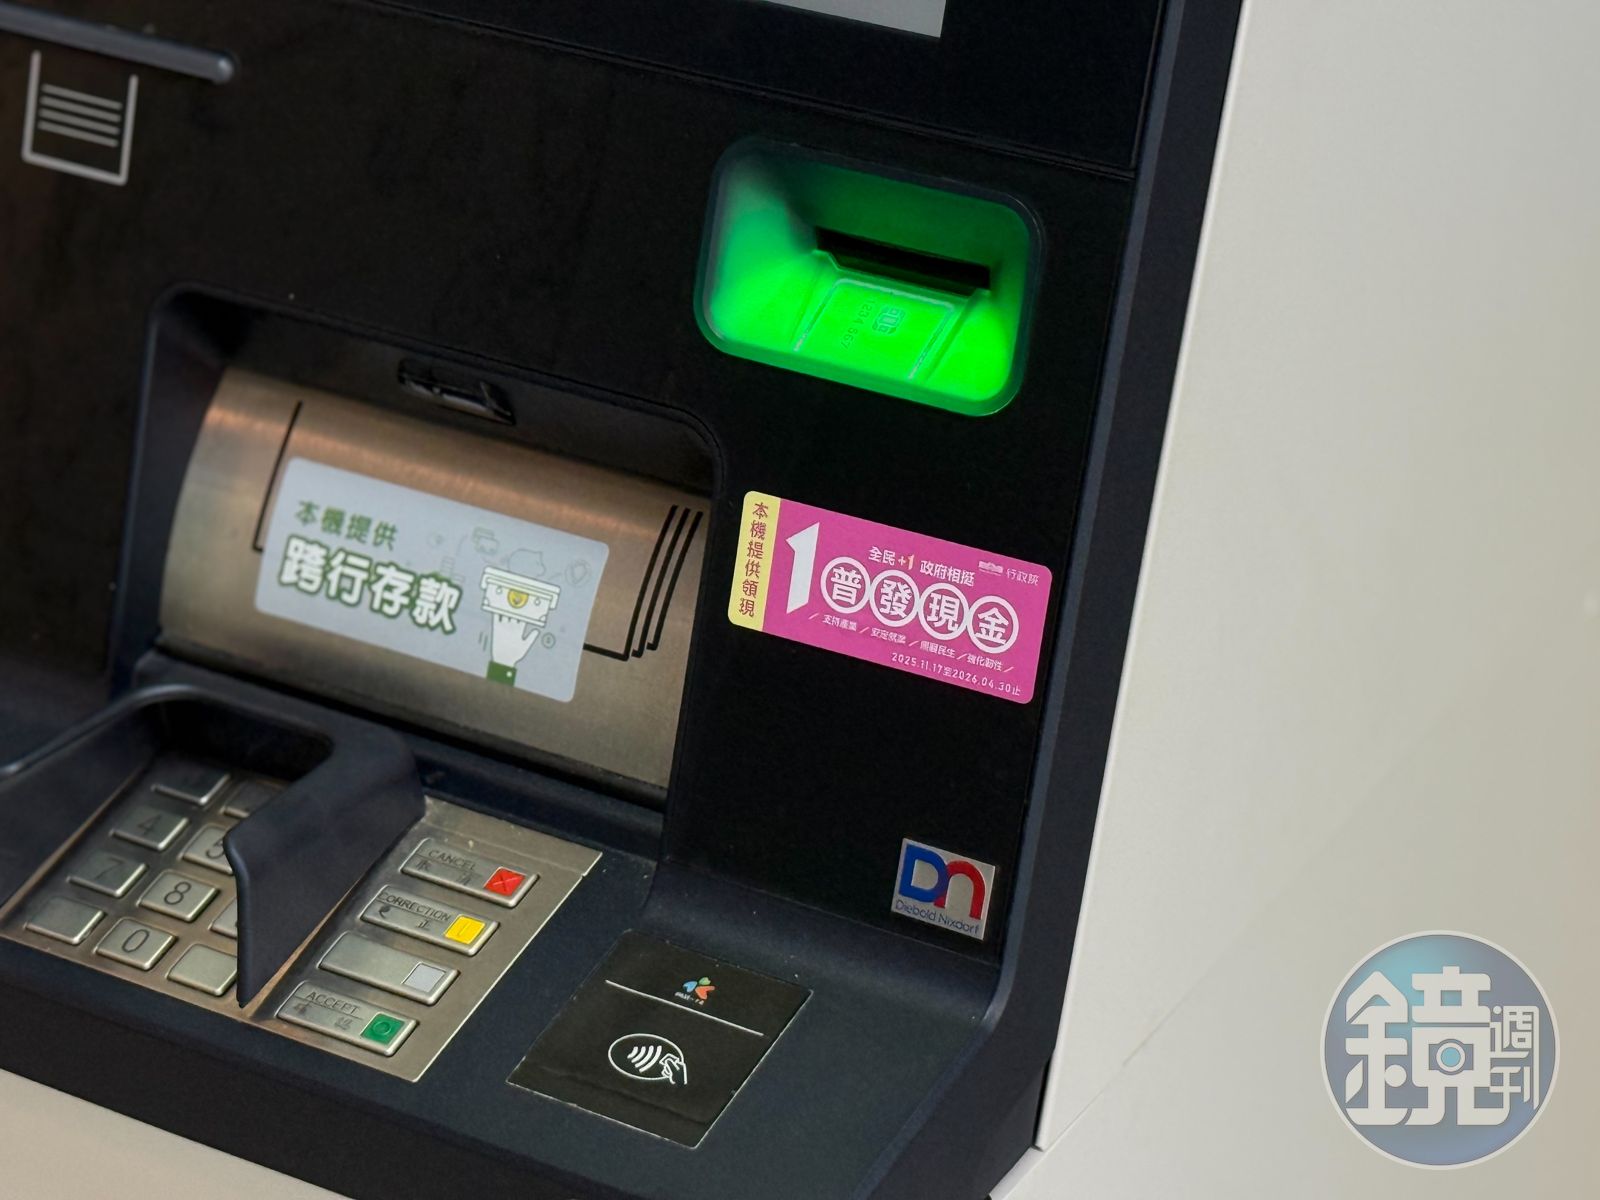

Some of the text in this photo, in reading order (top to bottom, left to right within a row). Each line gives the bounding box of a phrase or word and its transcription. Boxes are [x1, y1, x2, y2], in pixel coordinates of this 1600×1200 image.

[295, 499, 399, 552] 本機提供
[738, 501, 769, 618] 本機提供領現
[919, 559, 976, 588] 政府相挺
[279, 534, 463, 635] 跨行存款
[827, 564, 1010, 648] 普發現金
[138, 813, 162, 833] 4
[427, 848, 477, 872] CANCEL
[163, 881, 191, 905] 8
[895, 899, 980, 935] Diebold Nixdorf
[121, 928, 149, 954] 0
[305, 990, 361, 1015] ACCEPT
